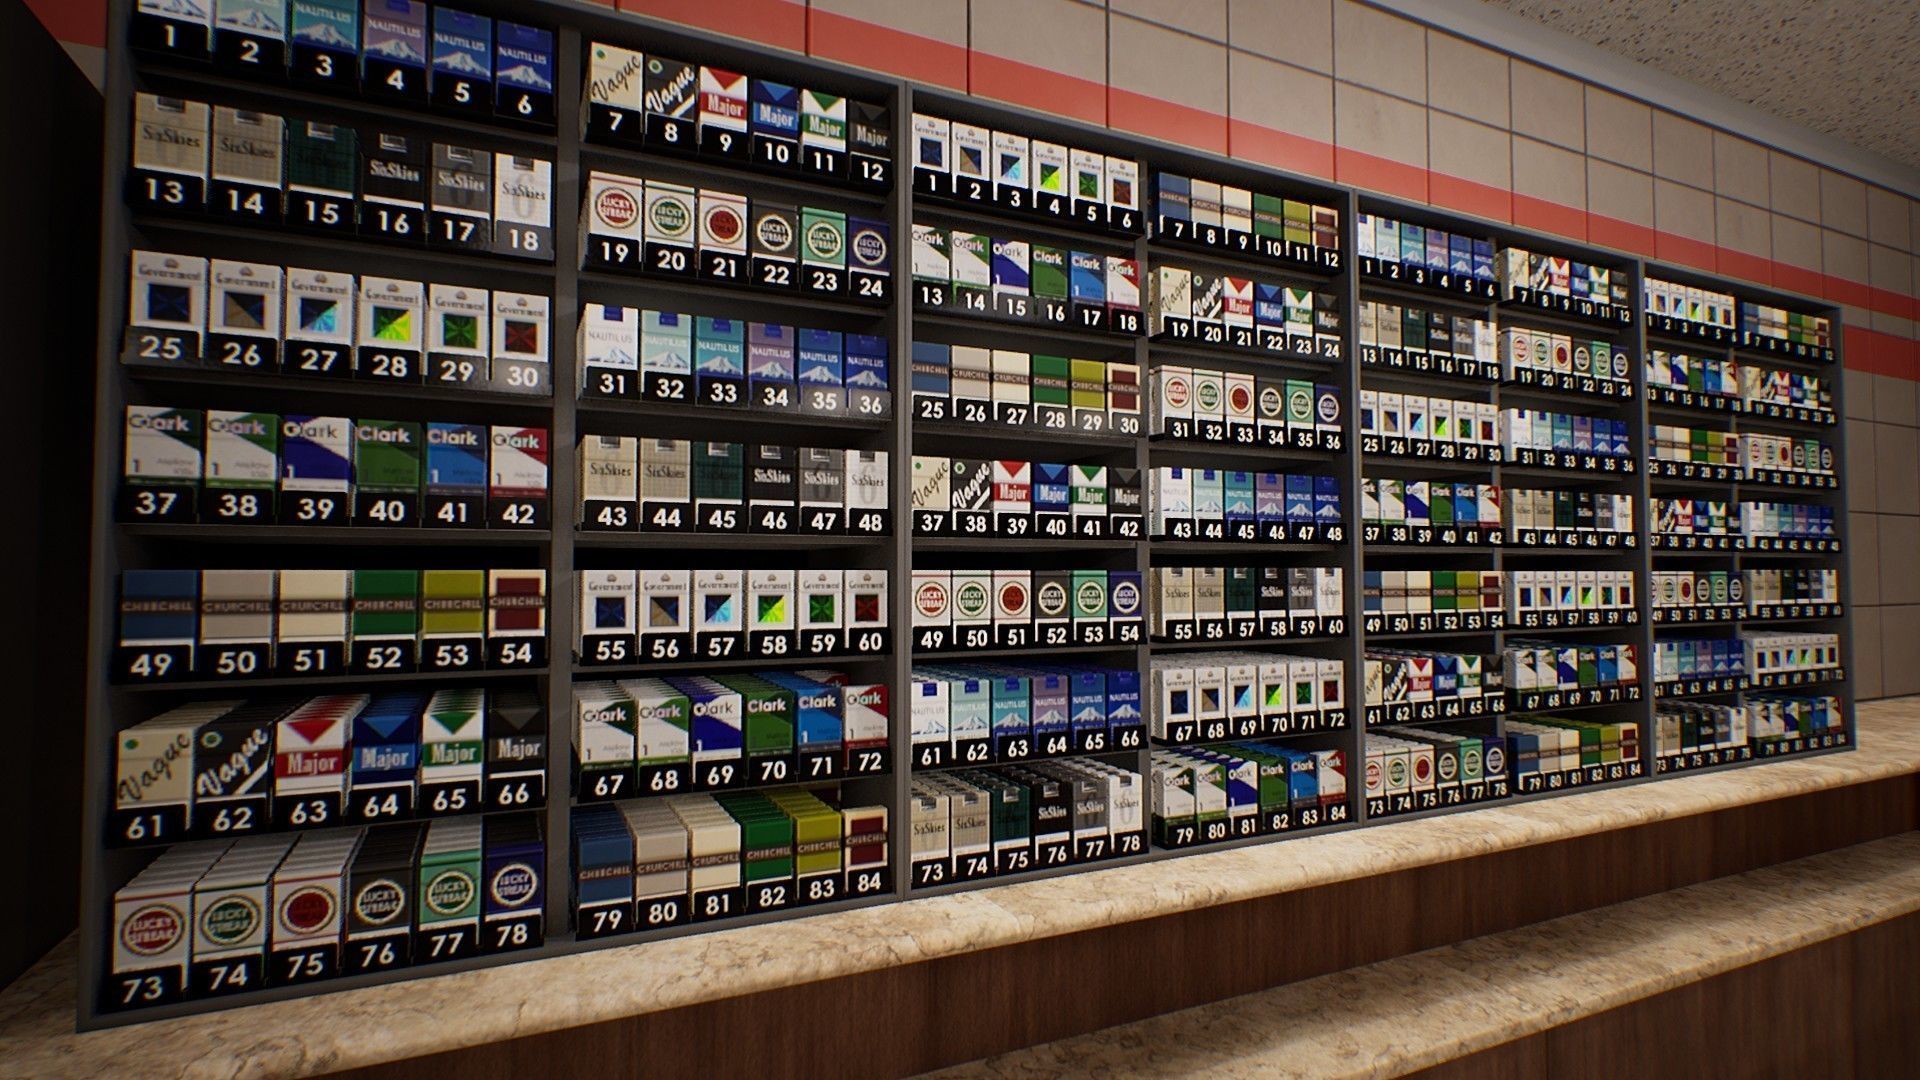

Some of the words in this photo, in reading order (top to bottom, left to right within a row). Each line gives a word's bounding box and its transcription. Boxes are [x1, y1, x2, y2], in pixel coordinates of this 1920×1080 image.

[165, 25, 174, 47] 1
[368, 17, 421, 38] NAUTILUS
[434, 31, 485, 52] NAUTILUS
[499, 45, 547, 65] NAUTILUS
[316, 55, 332, 76] 3
[387, 70, 404, 90] 4
[591, 56, 640, 100] Vague
[645, 66, 694, 113] Vague
[518, 94, 532, 114] 6
[708, 93, 743, 117] Major
[610, 112, 623, 131] 7
[760, 104, 794, 127] Major
[664, 123, 678, 142] 8
[809, 116, 841, 138] Major
[857, 126, 888, 146] Major
[765, 142, 789, 163] 10
[862, 161, 883, 181] 12
[146, 178, 183, 203] 13
[930, 174, 936, 191] 1
[1010, 190, 1021, 207] 3
[306, 200, 339, 224] 15
[1122, 213, 1132, 228] 6
[444, 220, 474, 242] 17
[1175, 222, 1184, 237] 7
[510, 229, 538, 251] 18
[1239, 235, 1248, 250] 9
[602, 242, 628, 262] 19
[1324, 252, 1338, 267] 12
[713, 257, 736, 278] 21
[1391, 265, 1398, 278] 2
[860, 278, 883, 297] 24
[965, 292, 985, 311] 14
[1581, 302, 1592, 315] 10
[1046, 304, 1065, 322] 16
[1172, 322, 1189, 338] 19
[140, 335, 181, 359] 25
[699, 341, 739, 353] NAUTILUS
[752, 346, 791, 359] NAUTILUS
[1267, 335, 1283, 351] 22
[223, 342, 261, 366] 26
[801, 352, 838, 364] NAUTILUS
[848, 356, 883, 368] NAUTILUS
[1415, 356, 1428, 370] 15
[372, 354, 407, 377] 28
[506, 365, 538, 387] 30
[600, 373, 624, 394] 31
[1583, 379, 1594, 392] 22
[710, 382, 737, 403] 33
[763, 387, 789, 407] 34
[859, 395, 882, 414] 36
[921, 400, 944, 419] 25
[129, 413, 189, 432] Clark
[1046, 411, 1066, 428] 28
[1120, 417, 1139, 434] 30
[283, 421, 338, 439] Clark
[358, 425, 410, 444] Clark
[428, 428, 478, 446] Clark
[1173, 422, 1188, 438] 31
[1268, 430, 1284, 445] 34
[493, 432, 538, 450] Clark
[1326, 434, 1341, 450] 36
[1416, 442, 1430, 456] 27
[1585, 456, 1596, 469] 34
[136, 492, 177, 514] 37
[297, 498, 334, 520] 39
[438, 502, 466, 522] 41
[598, 506, 627, 526] 43
[709, 510, 736, 528] 45
[858, 514, 882, 532] 48
[921, 514, 944, 531] 37
[1007, 518, 1028, 534] 39
[1120, 521, 1138, 537] 42
[1174, 522, 1192, 538] 43
[1269, 525, 1285, 540] 46
[1392, 528, 1406, 541] 38
[1444, 616, 1458, 630] 52
[1568, 612, 1579, 625] 57
[966, 629, 988, 647] 50
[1120, 625, 1139, 642] 54
[1174, 624, 1192, 640] 55
[1270, 621, 1286, 636] 58
[596, 640, 626, 660] 55
[761, 635, 787, 654] 58
[859, 632, 882, 651] 60
[131, 653, 172, 676] 49
[366, 646, 402, 668] 52
[436, 644, 468, 666] 53
[748, 699, 786, 713] Clark
[800, 696, 836, 710] Clark
[847, 693, 881, 706] Clark
[1446, 702, 1459, 716] 64
[583, 708, 626, 723] Clark
[694, 702, 732, 717] Clark
[1208, 722, 1224, 739] 68
[1272, 717, 1288, 732] 70
[498, 737, 540, 758] Major
[1008, 739, 1028, 757] 63
[1121, 730, 1140, 747] 66
[196, 729, 268, 796] Vague
[286, 753, 337, 774] Major
[362, 749, 409, 768] Major
[432, 744, 476, 764] Major
[859, 752, 882, 771] 72
[921, 747, 940, 766] 61
[119, 733, 191, 800] Vague
[762, 760, 786, 780] 70
[1611, 766, 1622, 778] 83
[499, 783, 529, 805] 66
[595, 774, 624, 796] 67
[1447, 789, 1460, 803] 76
[291, 800, 327, 824] 63
[1302, 809, 1318, 825] 83
[127, 814, 161, 839] 61
[1177, 827, 1194, 844] 79
[1086, 840, 1104, 858] 77
[967, 856, 988, 876] 74
[858, 872, 881, 892] 84
[759, 886, 785, 907] 82
[649, 902, 677, 923] 80
[497, 923, 528, 947] 78
[362, 942, 394, 967] 76
[124, 976, 163, 1003] 73
